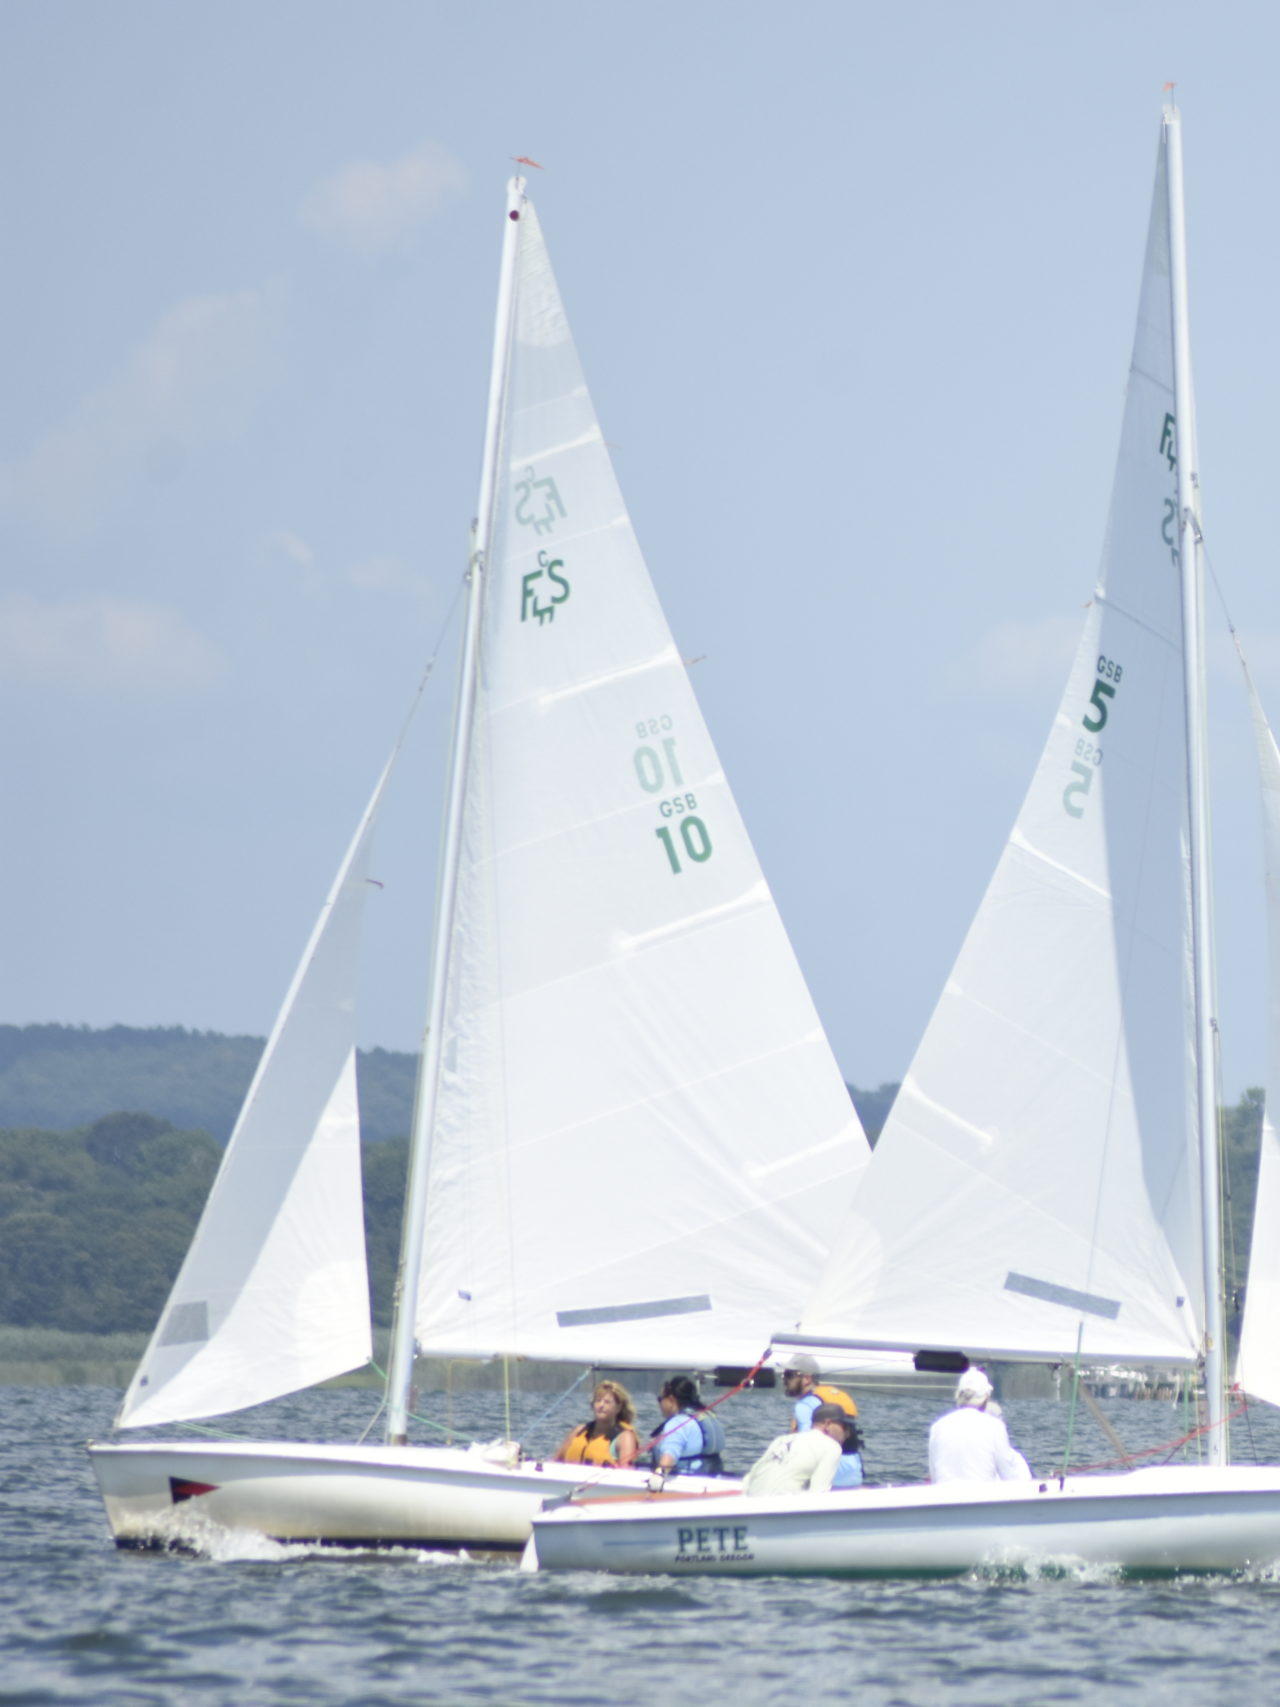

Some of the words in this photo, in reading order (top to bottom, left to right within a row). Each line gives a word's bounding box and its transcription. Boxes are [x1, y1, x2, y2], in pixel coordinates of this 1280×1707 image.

[1097, 655, 1123, 683] GSB
[1082, 679, 1117, 733] 5
[658, 793, 698, 818] GSB
[655, 815, 713, 874] 10
[677, 1526, 748, 1552] PETE
